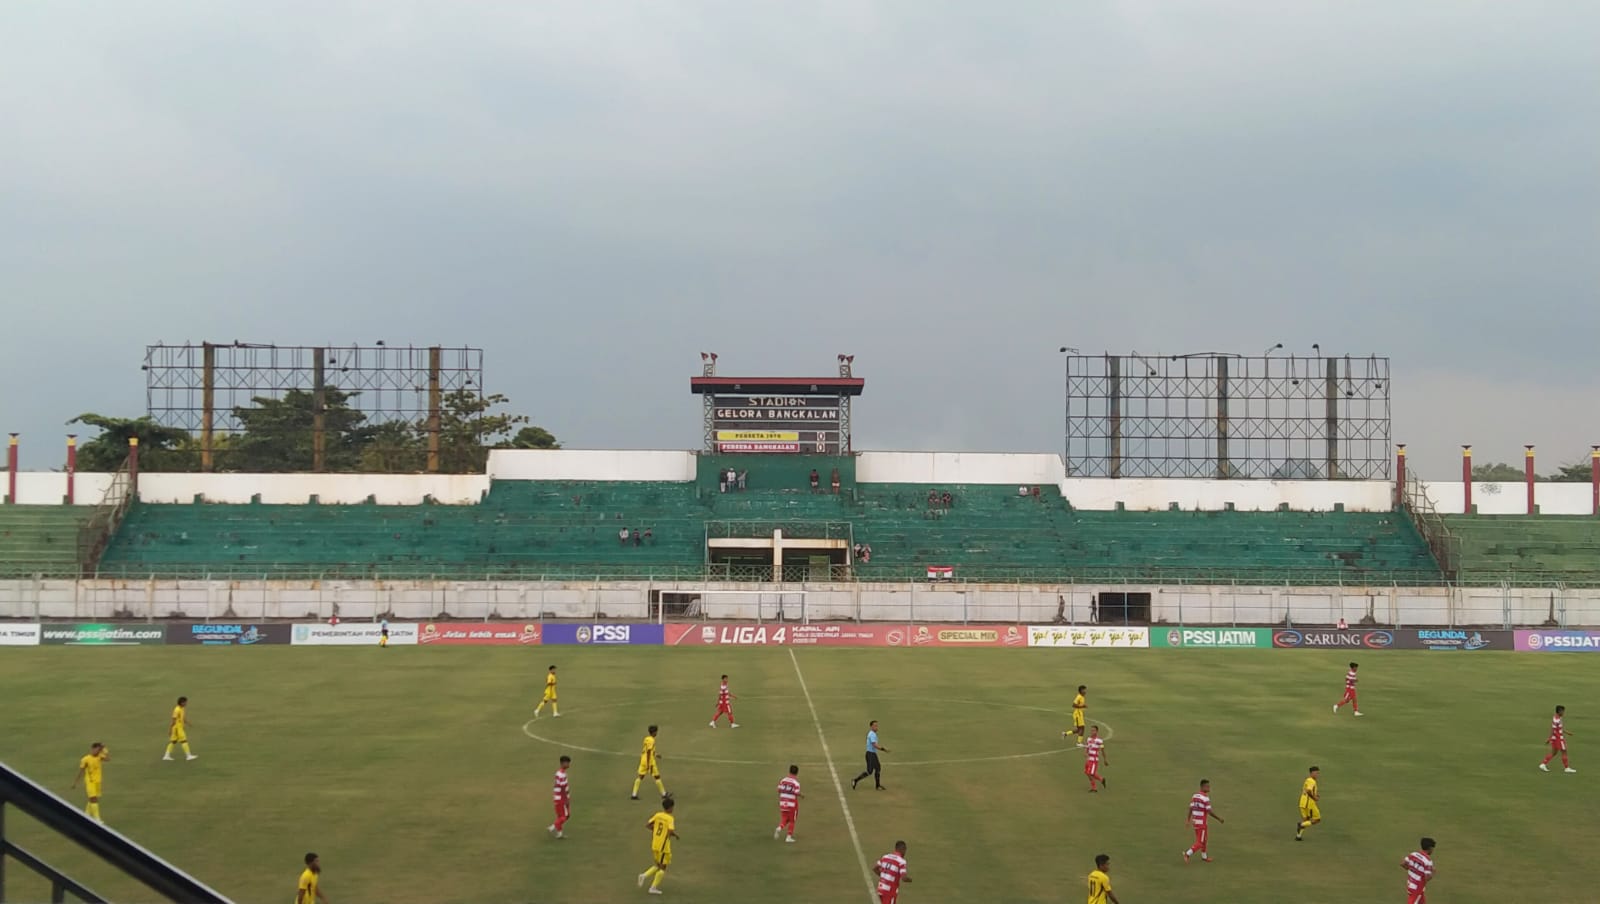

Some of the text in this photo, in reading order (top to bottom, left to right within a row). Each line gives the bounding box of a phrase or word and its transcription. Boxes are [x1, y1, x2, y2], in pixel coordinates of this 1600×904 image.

[748, 397, 807, 406] STADION
[717, 409, 837, 419] GELORA BANGKALAN
[43, 628, 162, 641] www.pssijatim.com
[593, 625, 630, 641] PSSI
[720, 627, 786, 644] LIGA 4
[940, 631, 978, 640] SPECIAL
[980, 631, 997, 640] MIX
[1183, 630, 1256, 645] PSSI JATIM
[1418, 630, 1468, 639] BEGUNDAL
[1304, 633, 1361, 646] SARUNG
[1544, 636, 1600, 647] PSSIJAT
